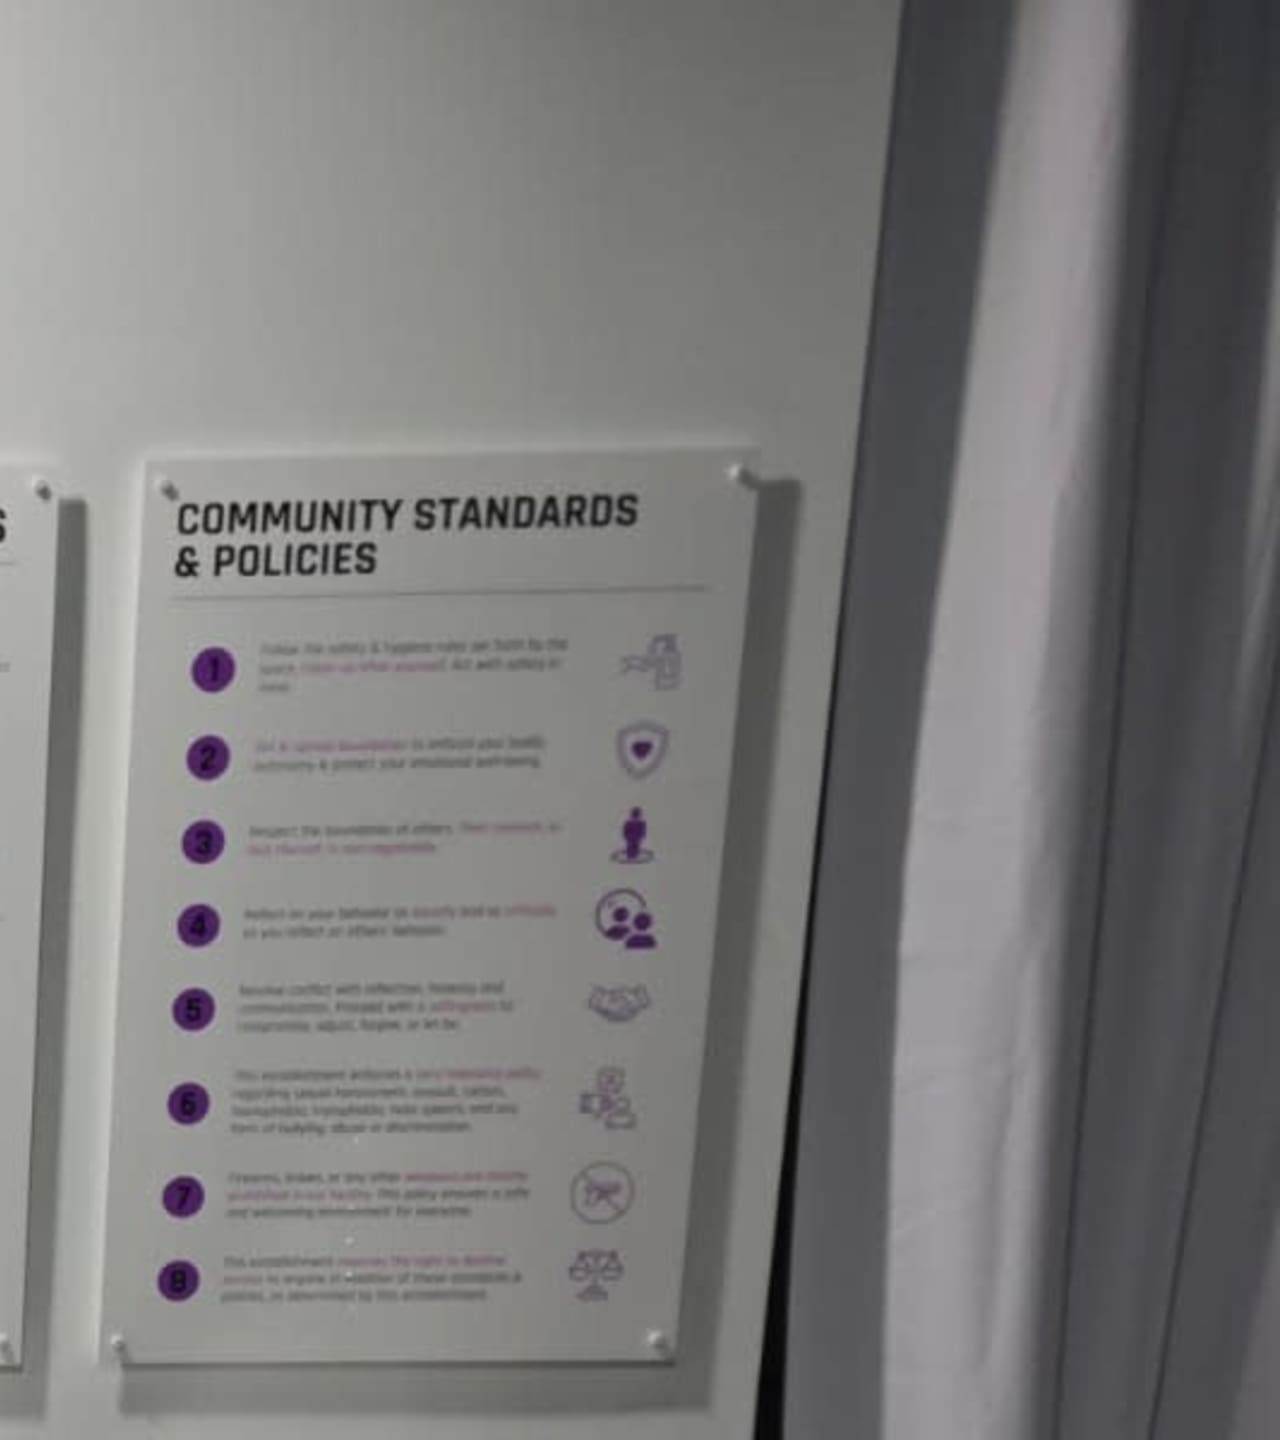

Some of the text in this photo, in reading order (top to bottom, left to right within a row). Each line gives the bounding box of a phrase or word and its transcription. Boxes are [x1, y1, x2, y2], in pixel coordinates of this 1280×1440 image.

[177, 494, 638, 534] COMMUNITY STANDARDS
[175, 542, 376, 577] & POLICIES
[211, 657, 219, 680] 1
[200, 746, 216, 770] 2
[195, 829, 212, 854] 3
[189, 913, 205, 937] 4
[186, 998, 201, 1021] 5
[181, 1092, 195, 1116] 6
[177, 1185, 190, 1209] 7
[171, 1268, 186, 1293] 8
